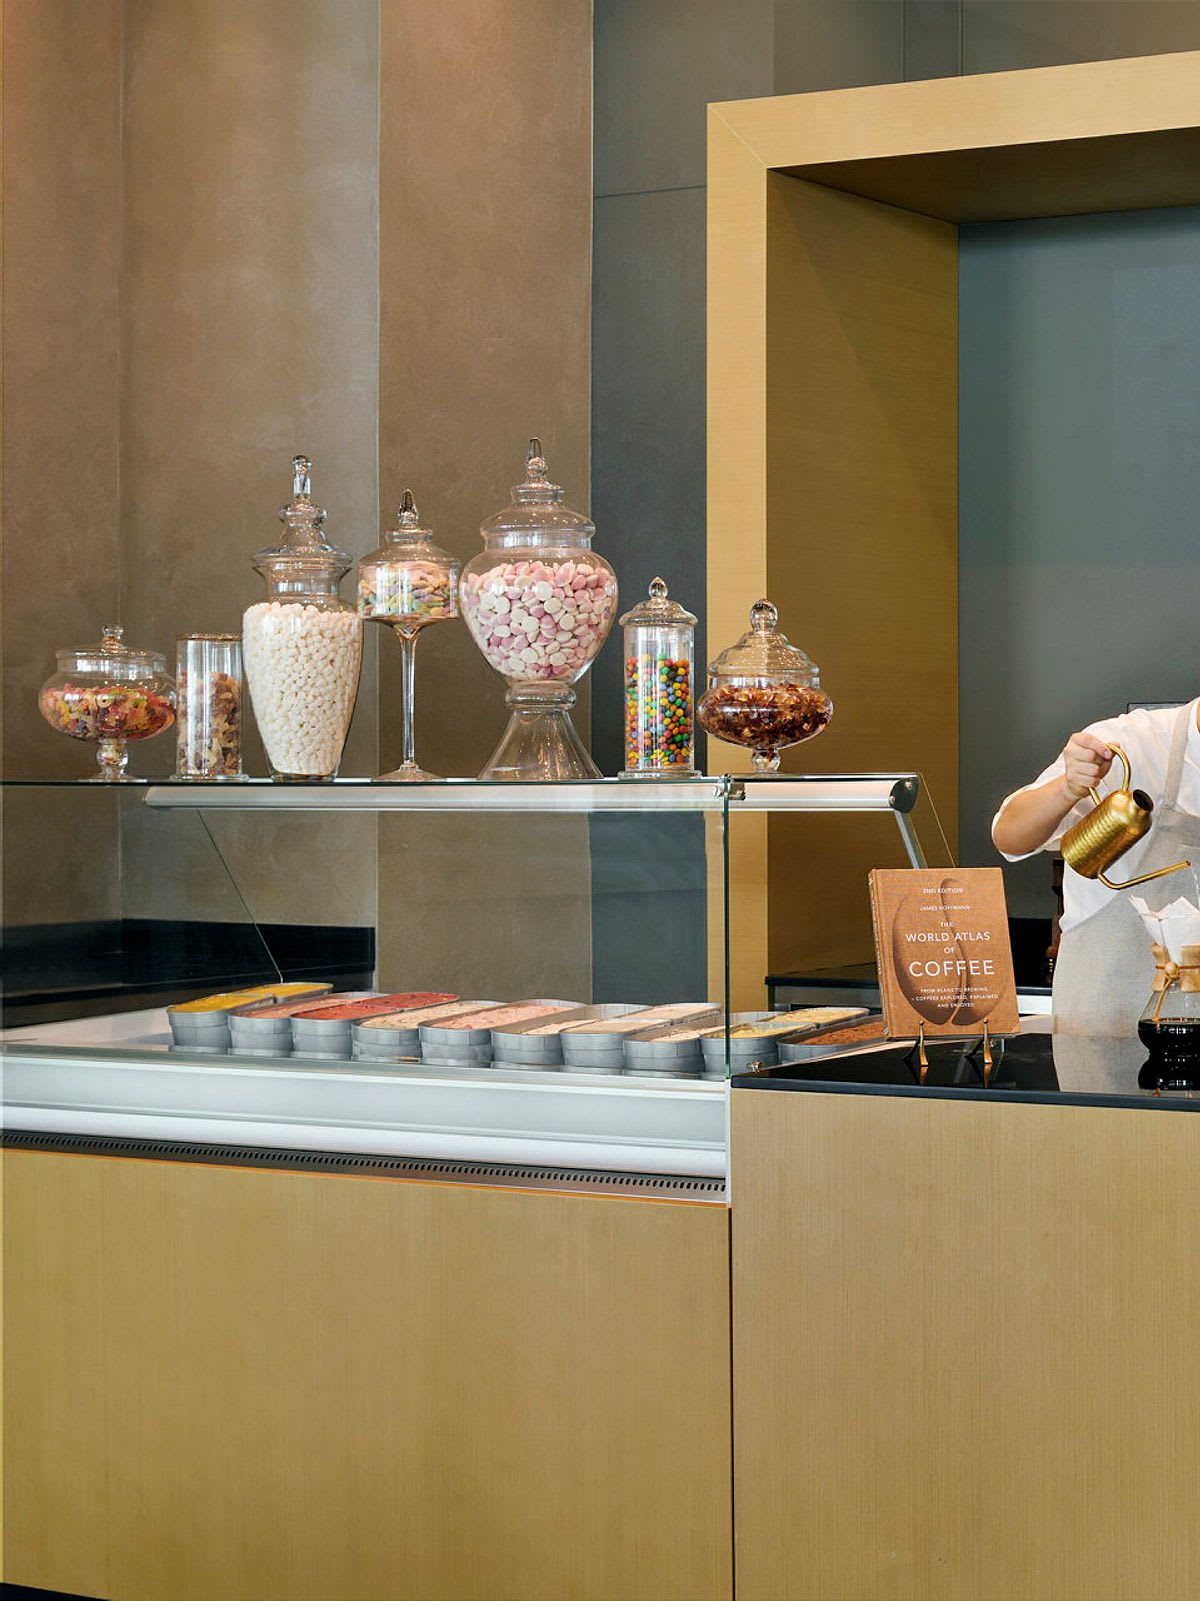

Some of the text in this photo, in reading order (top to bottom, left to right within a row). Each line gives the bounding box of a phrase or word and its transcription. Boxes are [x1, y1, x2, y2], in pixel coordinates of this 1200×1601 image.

[905, 931, 991, 942] WORLD ATLAS
[943, 946, 956, 954] OF
[908, 960, 996, 977] COFFEE
